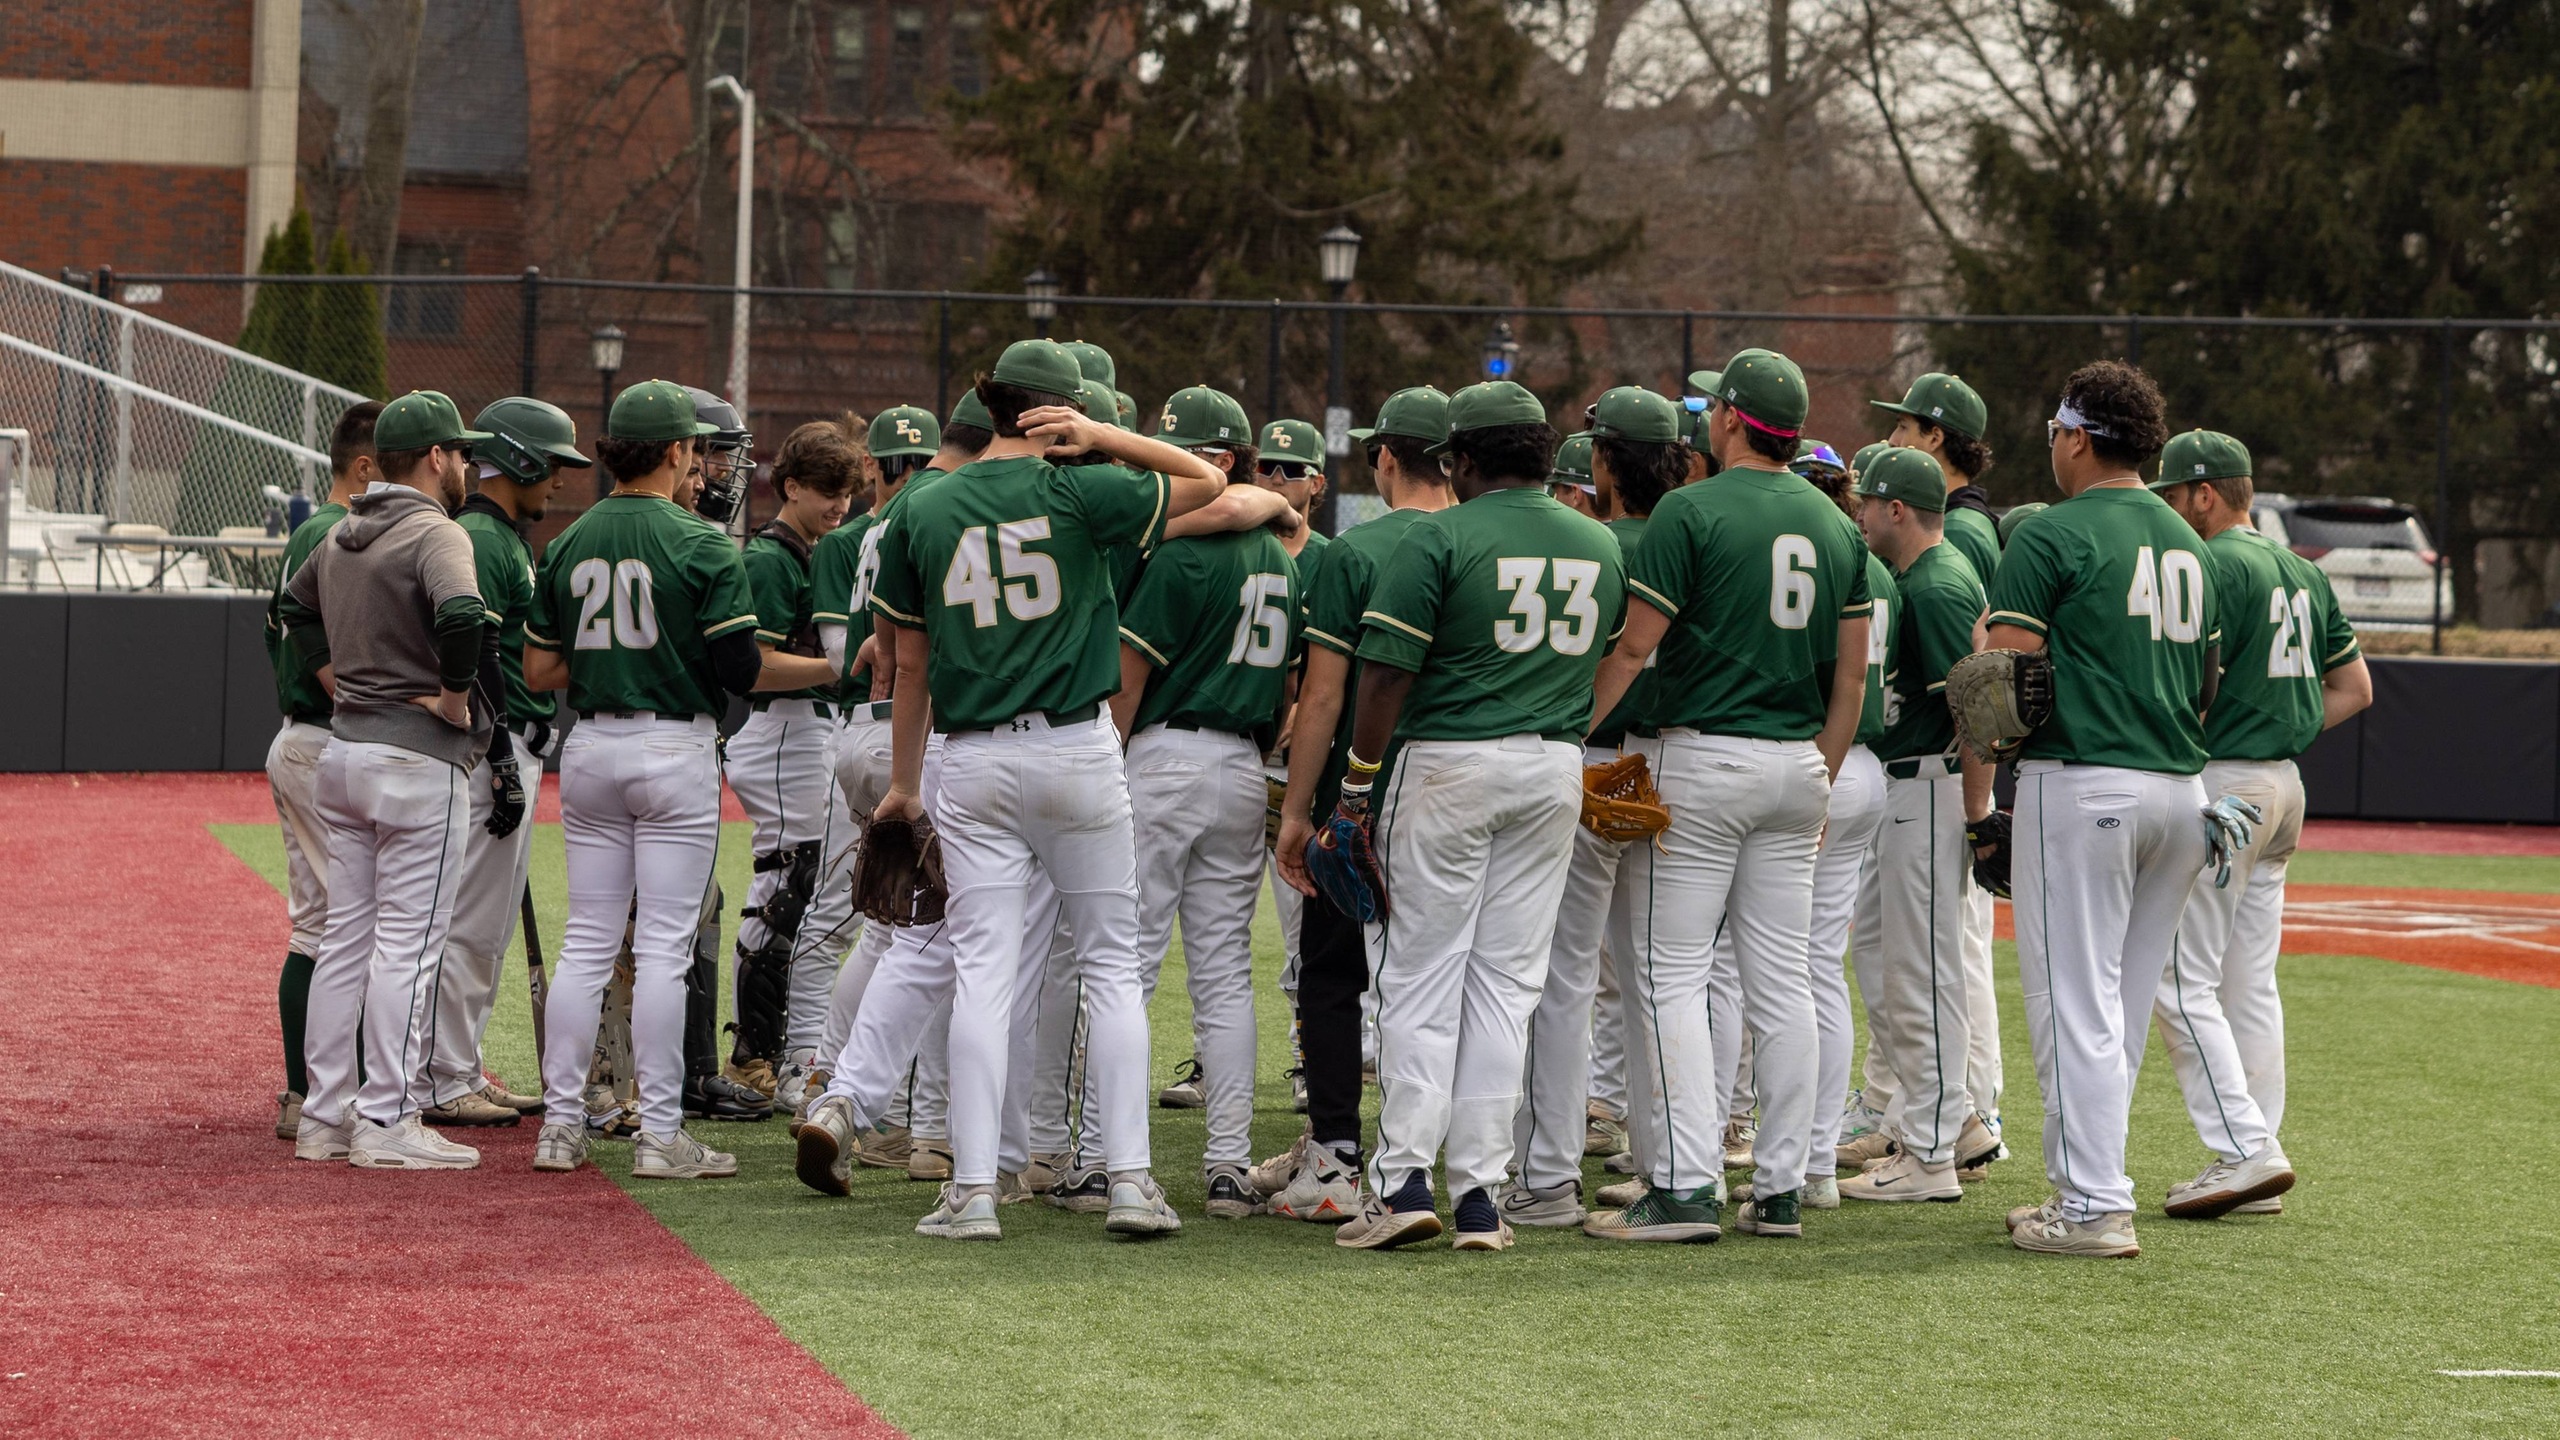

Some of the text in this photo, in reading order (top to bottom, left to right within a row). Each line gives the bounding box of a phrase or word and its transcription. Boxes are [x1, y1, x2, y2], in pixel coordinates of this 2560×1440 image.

[896, 419, 922, 443] EC
[1271, 426, 1292, 448] EC
[570, 558, 660, 649] 20
[943, 516, 1061, 628] 45
[1494, 557, 1601, 656] 33
[1770, 534, 1817, 629] 6
[2127, 546, 2203, 643] 40
[1227, 573, 1288, 668] 15
[2268, 586, 2316, 678] 21
